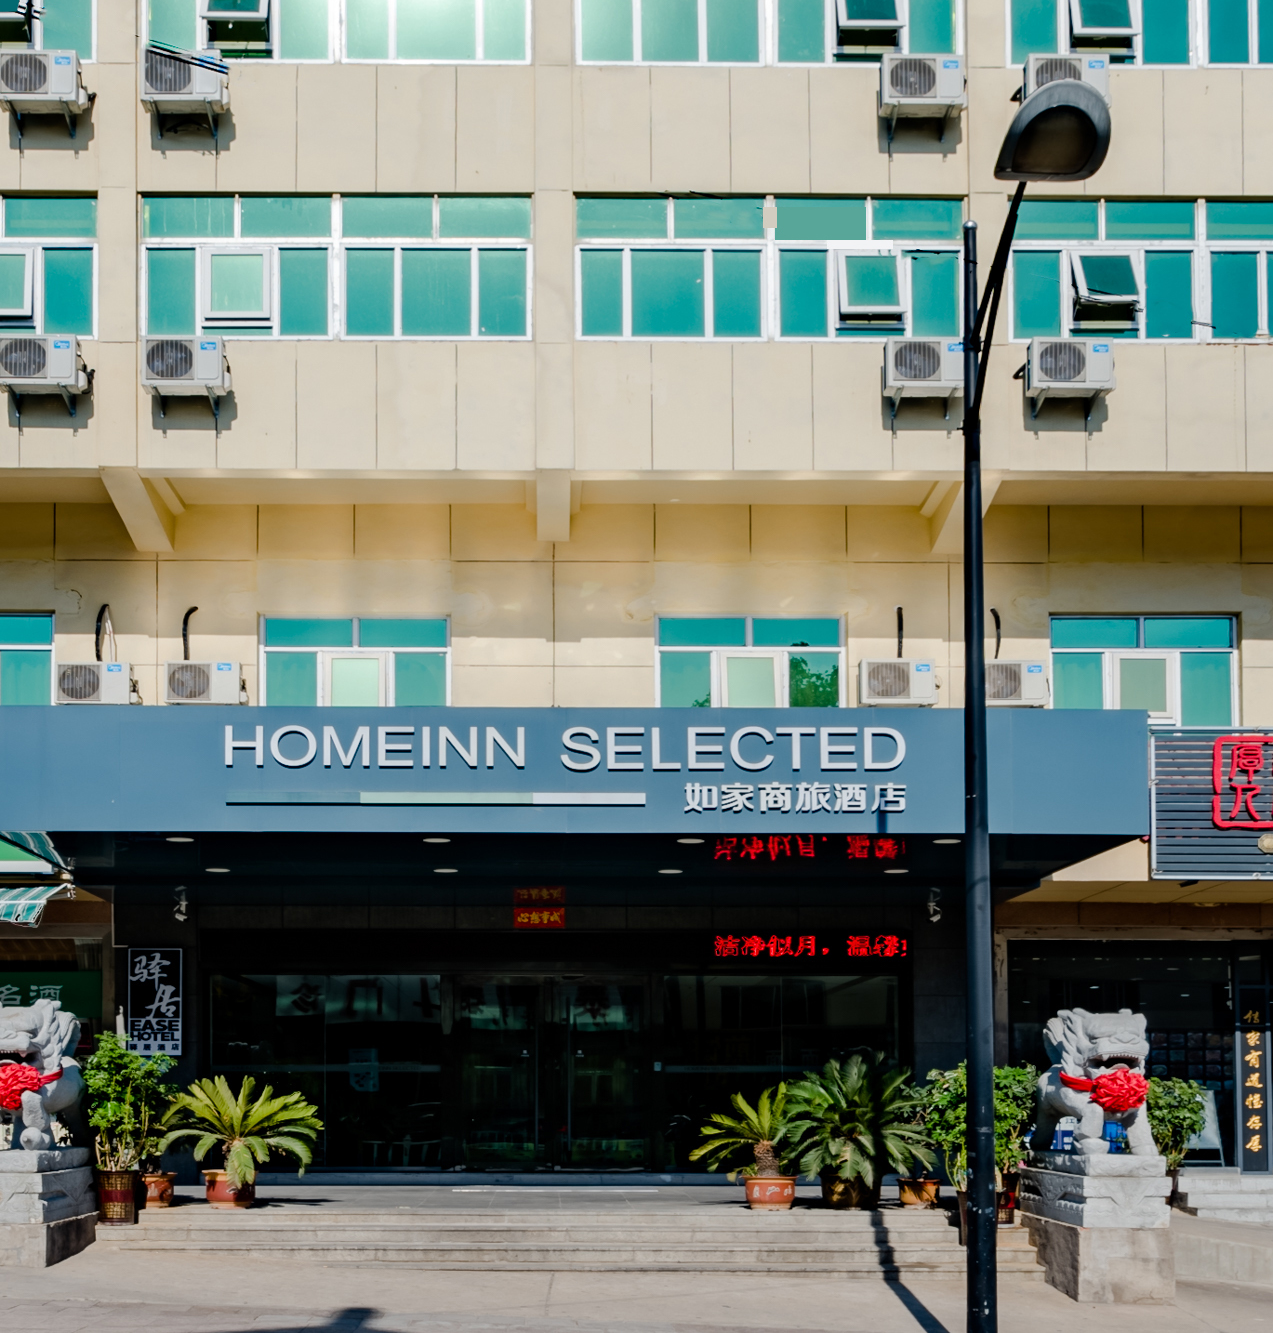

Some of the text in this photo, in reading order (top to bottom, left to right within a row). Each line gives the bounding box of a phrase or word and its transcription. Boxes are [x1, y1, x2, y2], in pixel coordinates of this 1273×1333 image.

[223, 724, 906, 772] HOMEINN SELECTED
[684, 782, 907, 814] 如家商旅酒店
[130, 1019, 180, 1032] EASE
[130, 1031, 180, 1042] HOTEL
